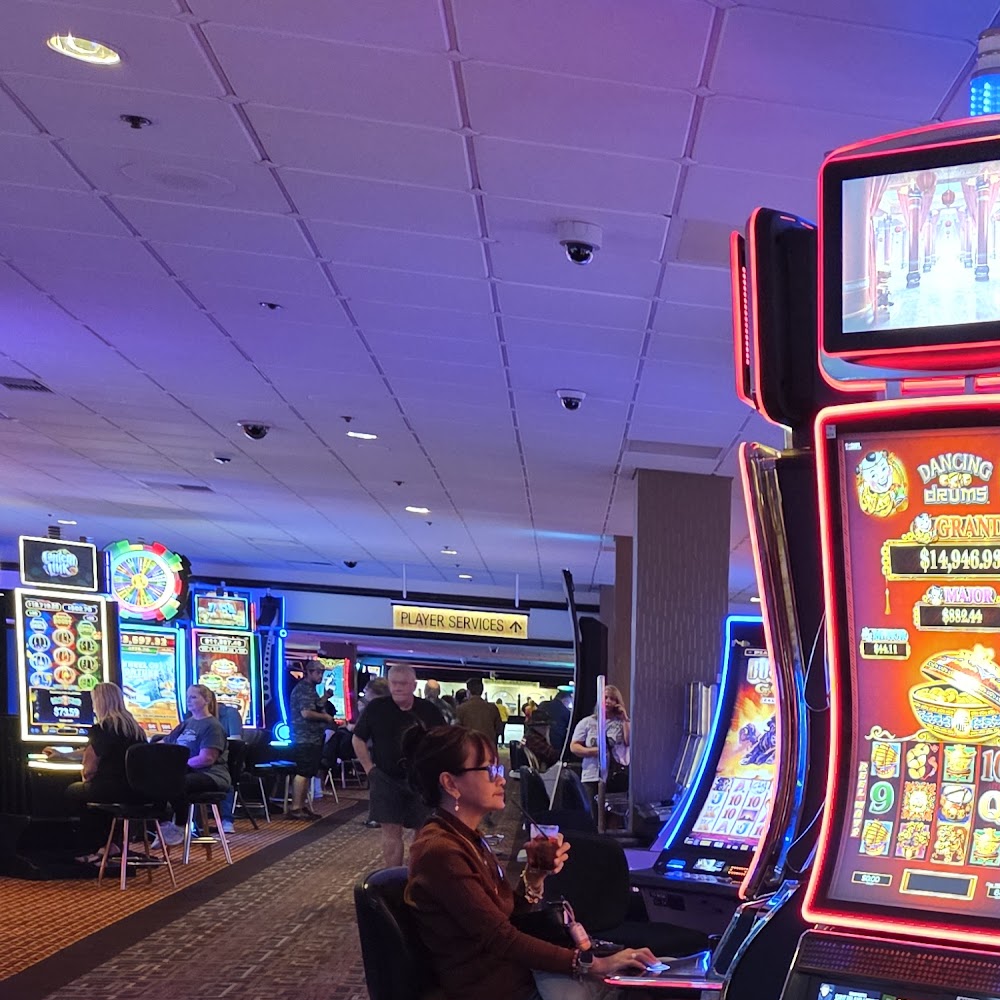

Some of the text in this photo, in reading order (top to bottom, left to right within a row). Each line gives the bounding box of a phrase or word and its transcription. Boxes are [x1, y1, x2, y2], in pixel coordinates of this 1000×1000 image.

[917, 452, 994, 484] DANCING
[944, 587, 994, 604] MAJOR
[401, 611, 504, 632] PLAYER SERVICES
[728, 794, 743, 807] 10
[747, 796, 761, 808] 10
[869, 781, 895, 814] 9
[722, 807, 737, 820] 10
